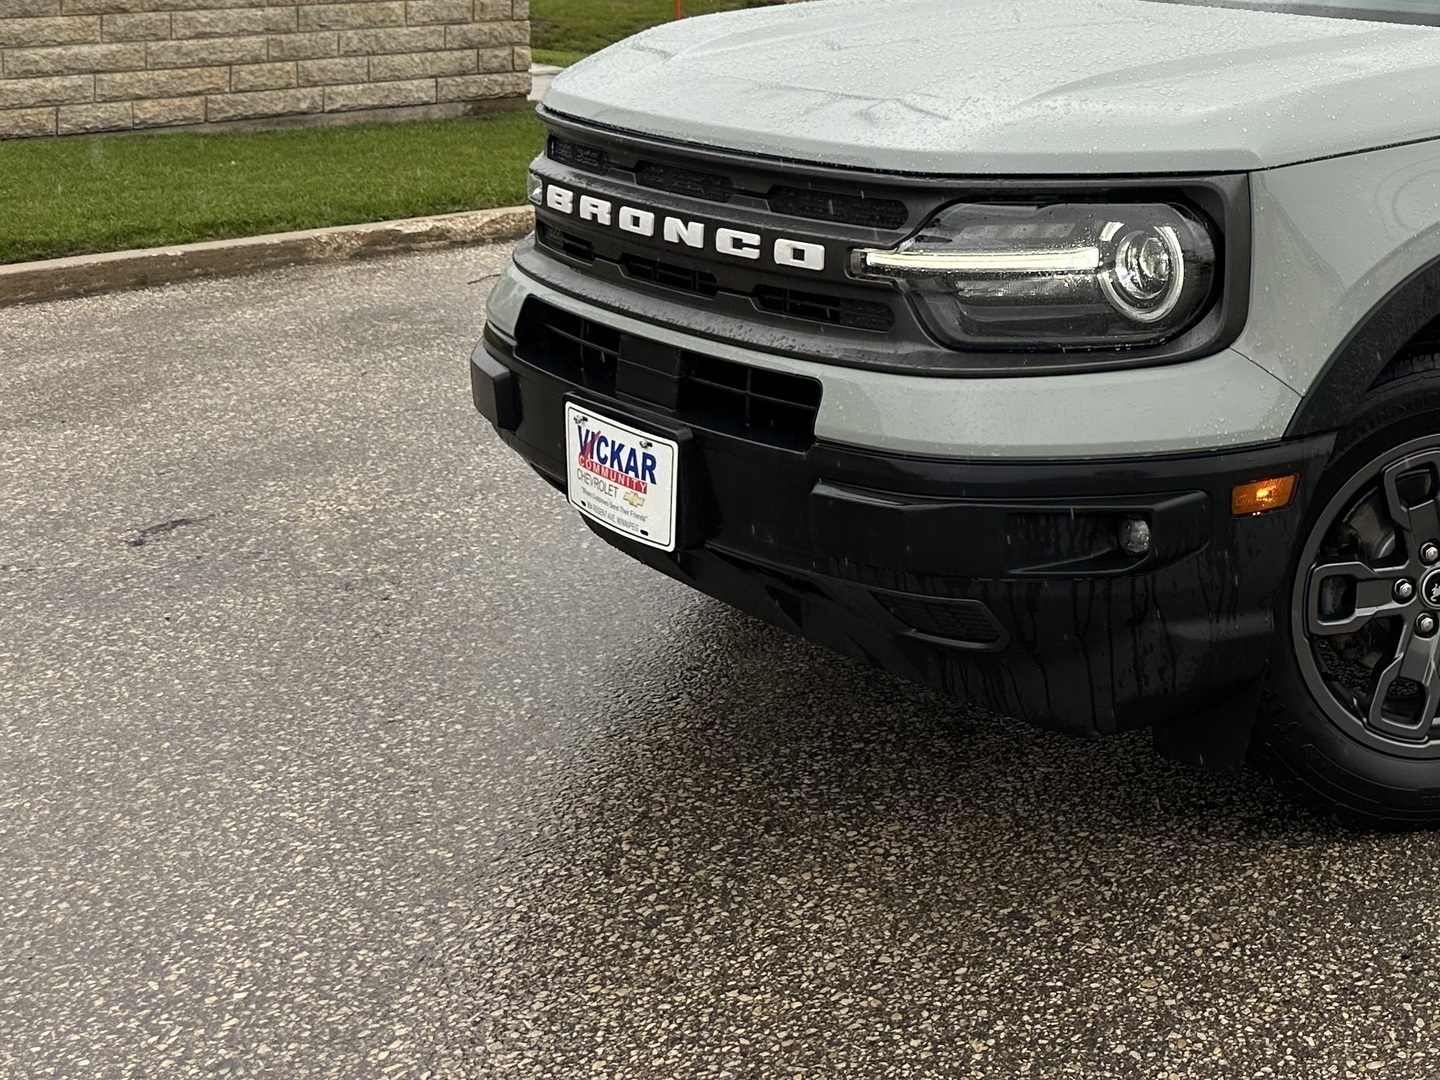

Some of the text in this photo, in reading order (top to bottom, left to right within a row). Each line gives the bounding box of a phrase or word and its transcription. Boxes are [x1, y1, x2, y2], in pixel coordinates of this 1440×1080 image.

[546, 184, 825, 271] BRONCO
[577, 425, 657, 485] VICKAR
[578, 455, 647, 494] COMMUNITY
[577, 468, 619, 498] CHEVROLET
